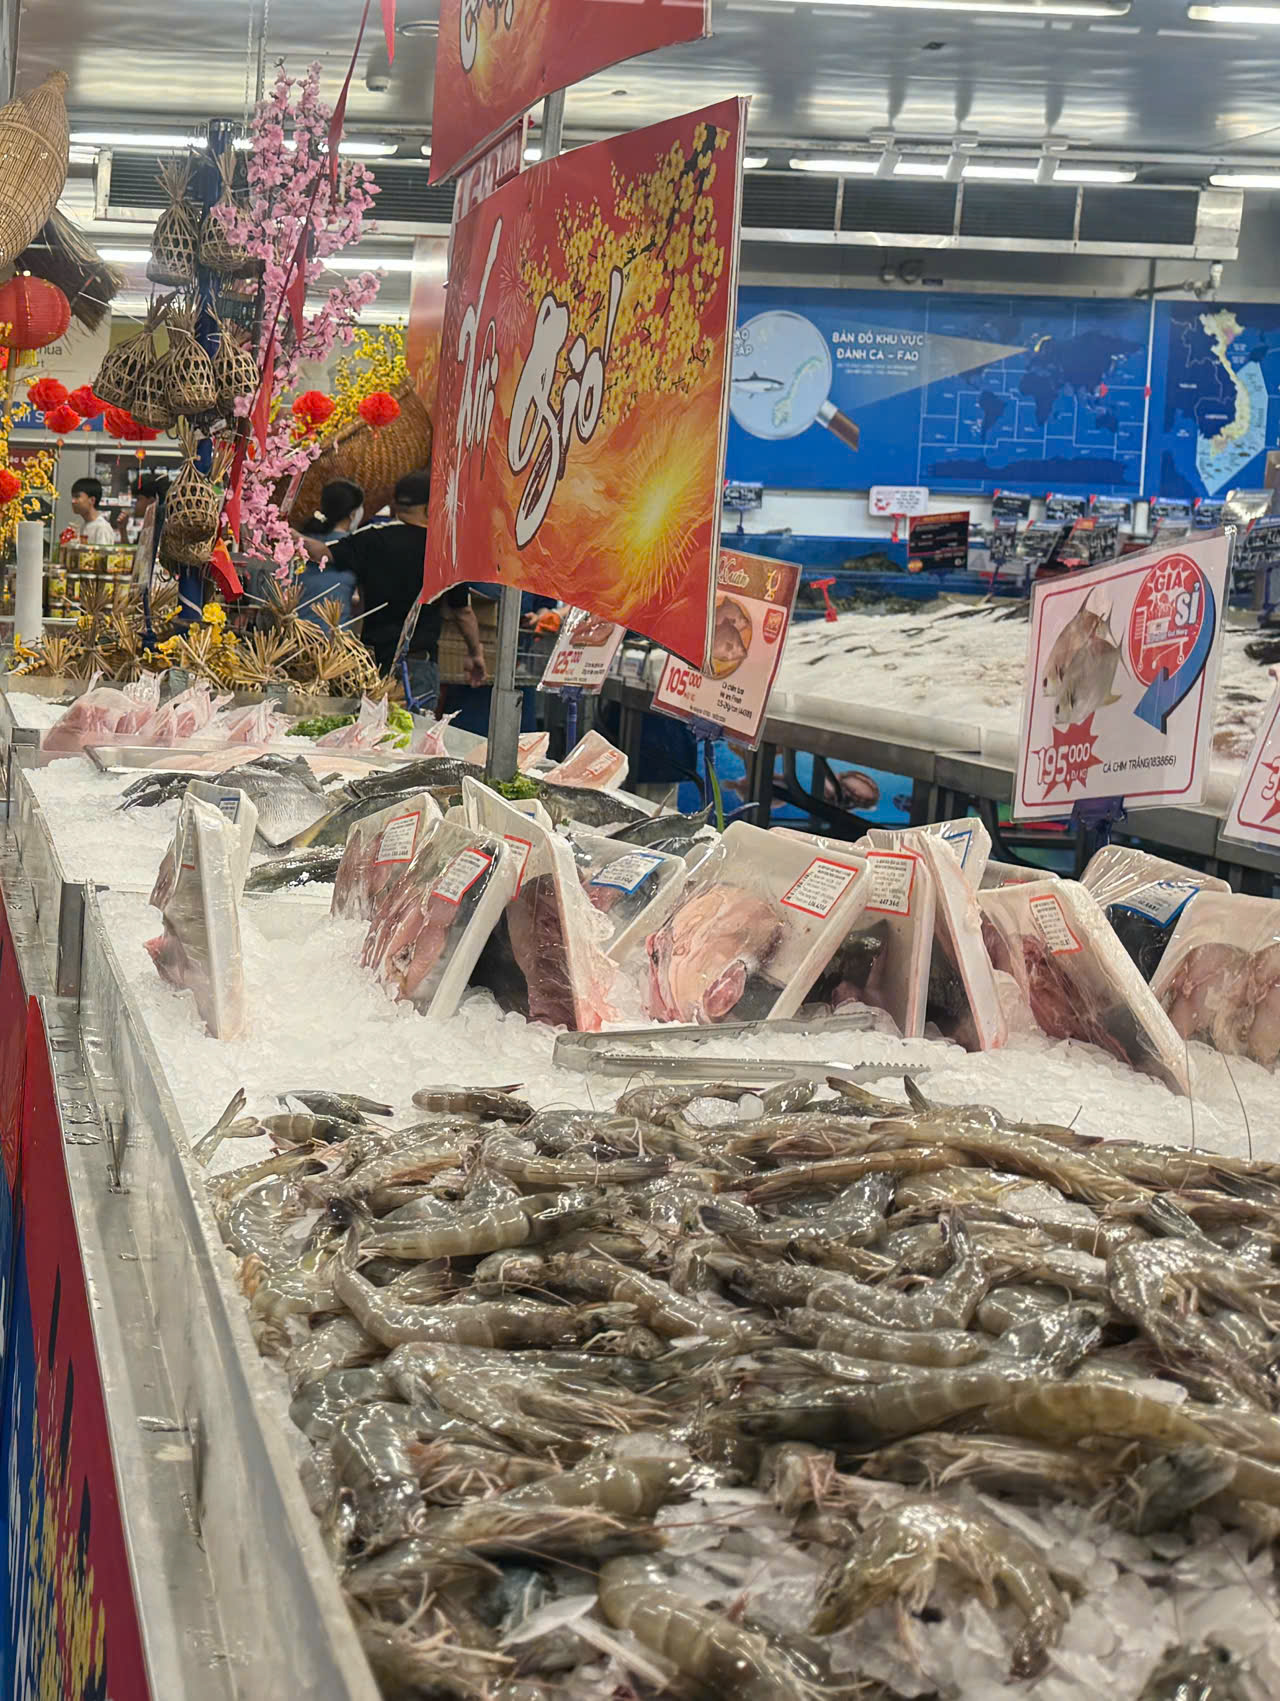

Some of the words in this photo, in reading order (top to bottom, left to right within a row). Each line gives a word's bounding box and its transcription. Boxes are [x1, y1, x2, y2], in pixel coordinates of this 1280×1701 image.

[832, 330, 855, 344] BẢN
[876, 334, 898, 345] KHU
[897, 350, 919, 361] FAO
[1153, 563, 1184, 594] GIÁ
